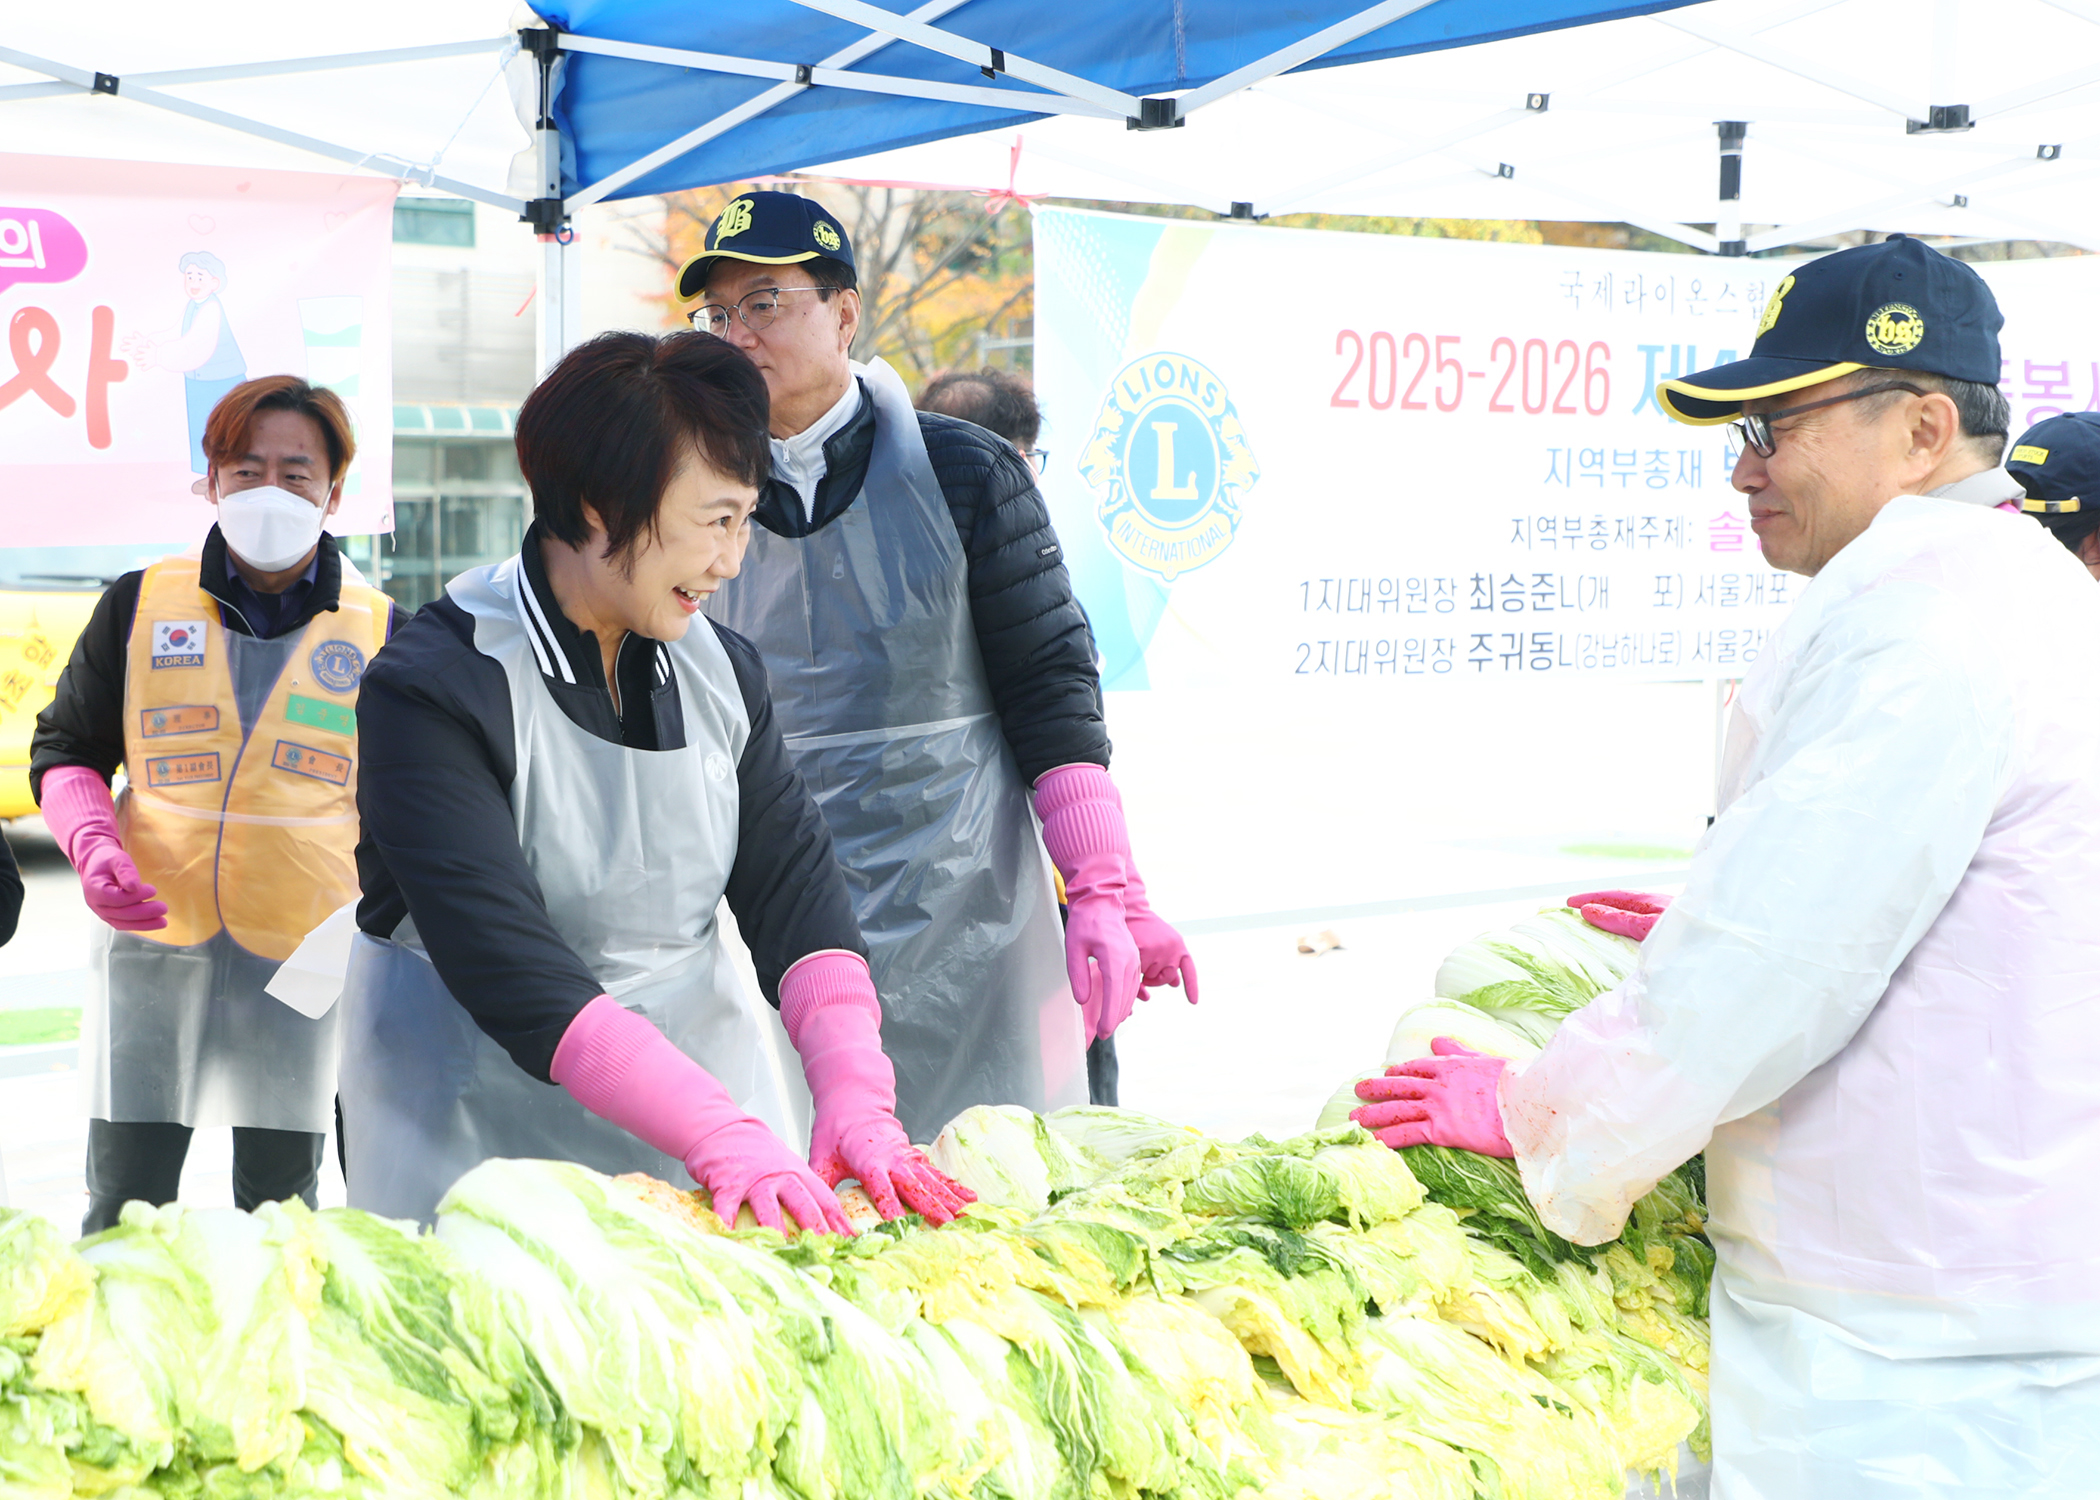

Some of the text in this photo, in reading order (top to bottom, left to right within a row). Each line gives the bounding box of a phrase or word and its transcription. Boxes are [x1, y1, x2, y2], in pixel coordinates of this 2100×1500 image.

[1121, 359, 1219, 409] LIONS
[1329, 328, 1612, 416] 2025-2026
[1150, 421, 1199, 500] L
[1543, 447, 1702, 490] 지역부총재
[1116, 519, 1226, 563] INTERNATIONAL
[1510, 514, 1693, 551] 지역부총재주제:
[1299, 576, 1458, 614] 1지대위원장
[156, 655, 201, 667] KOREA
[1295, 637, 1457, 676] 2지대위원장
[1692, 630, 1770, 664] 서울강
